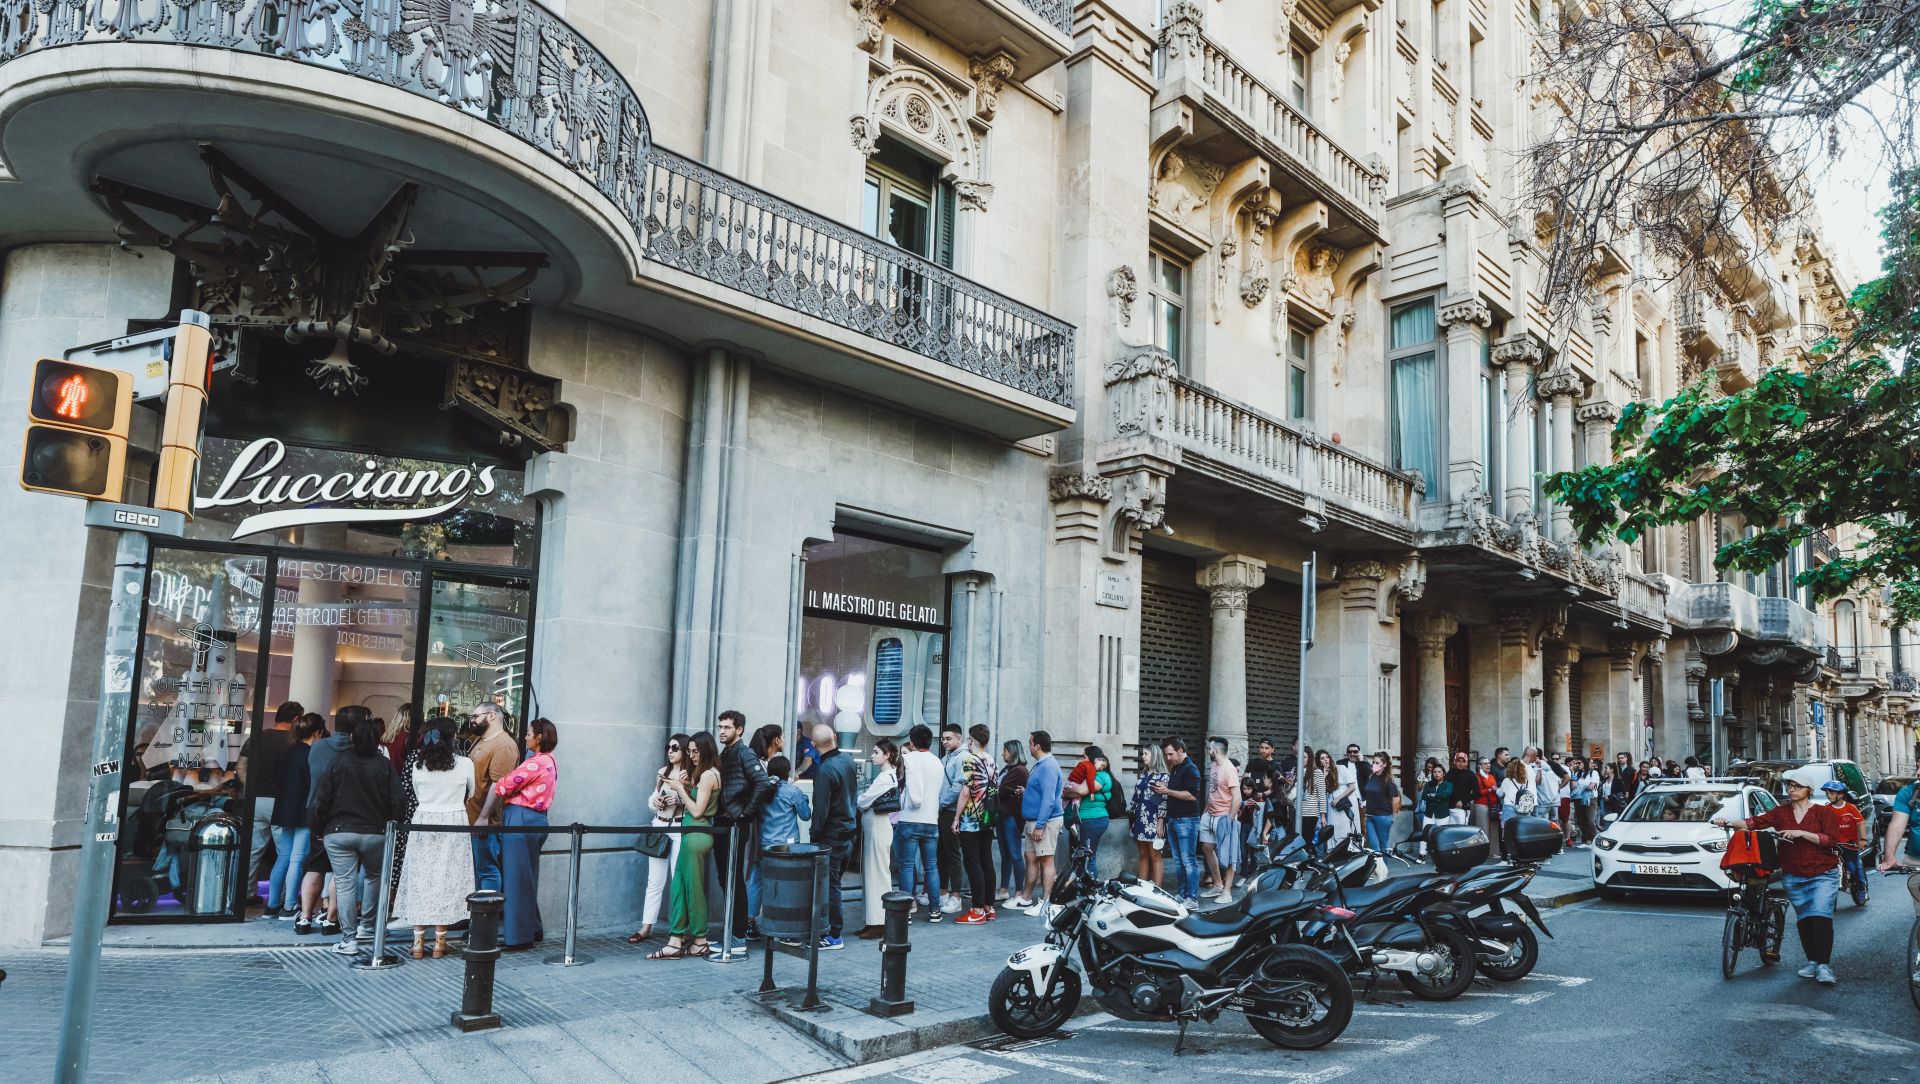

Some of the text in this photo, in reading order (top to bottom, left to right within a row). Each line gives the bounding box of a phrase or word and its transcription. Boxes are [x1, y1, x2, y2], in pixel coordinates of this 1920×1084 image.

[195, 437, 496, 540] Lucciano's
[808, 589, 937, 625] IL MAESTRO DEL GELATO
[157, 675, 240, 695] GELATO
[146, 701, 245, 720] STATION
[173, 726, 214, 745] BCN
[93, 760, 121, 776] NEW
[1638, 865, 1679, 874] 1286 KZS
